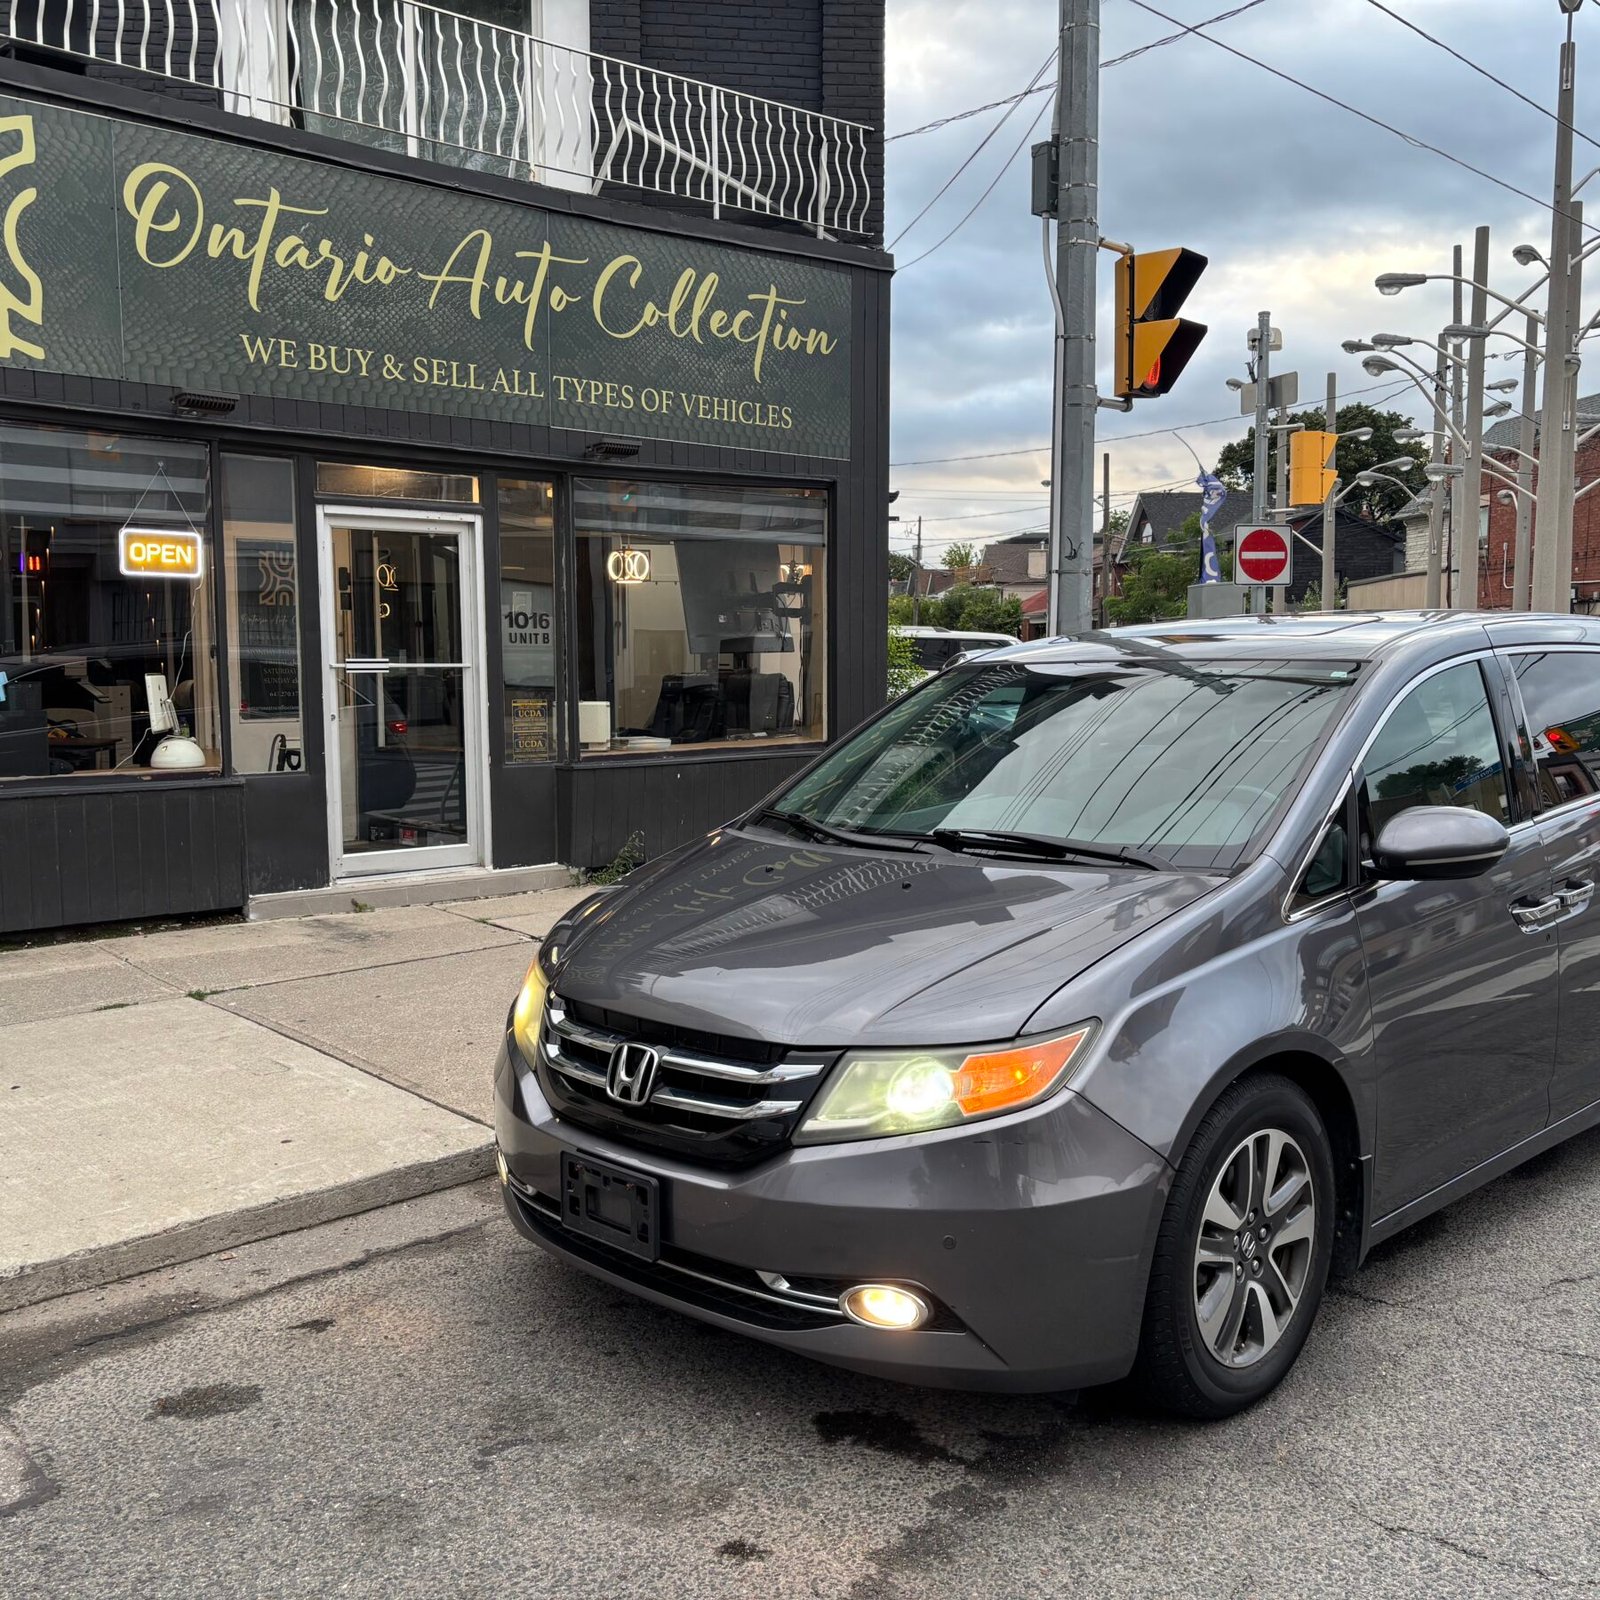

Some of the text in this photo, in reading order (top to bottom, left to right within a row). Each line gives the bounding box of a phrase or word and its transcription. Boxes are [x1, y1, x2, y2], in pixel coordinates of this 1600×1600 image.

[123, 162, 838, 383] Ontario Auto Collection
[239, 333, 793, 429] WE BUY & SELL ALL TYPES OF VEHICLES
[129, 542, 193, 564] OPEN
[505, 611, 550, 629] 1016
[509, 632, 550, 645] UNIT B
[518, 709, 542, 718] UCDA
[518, 740, 543, 748] UCDA
